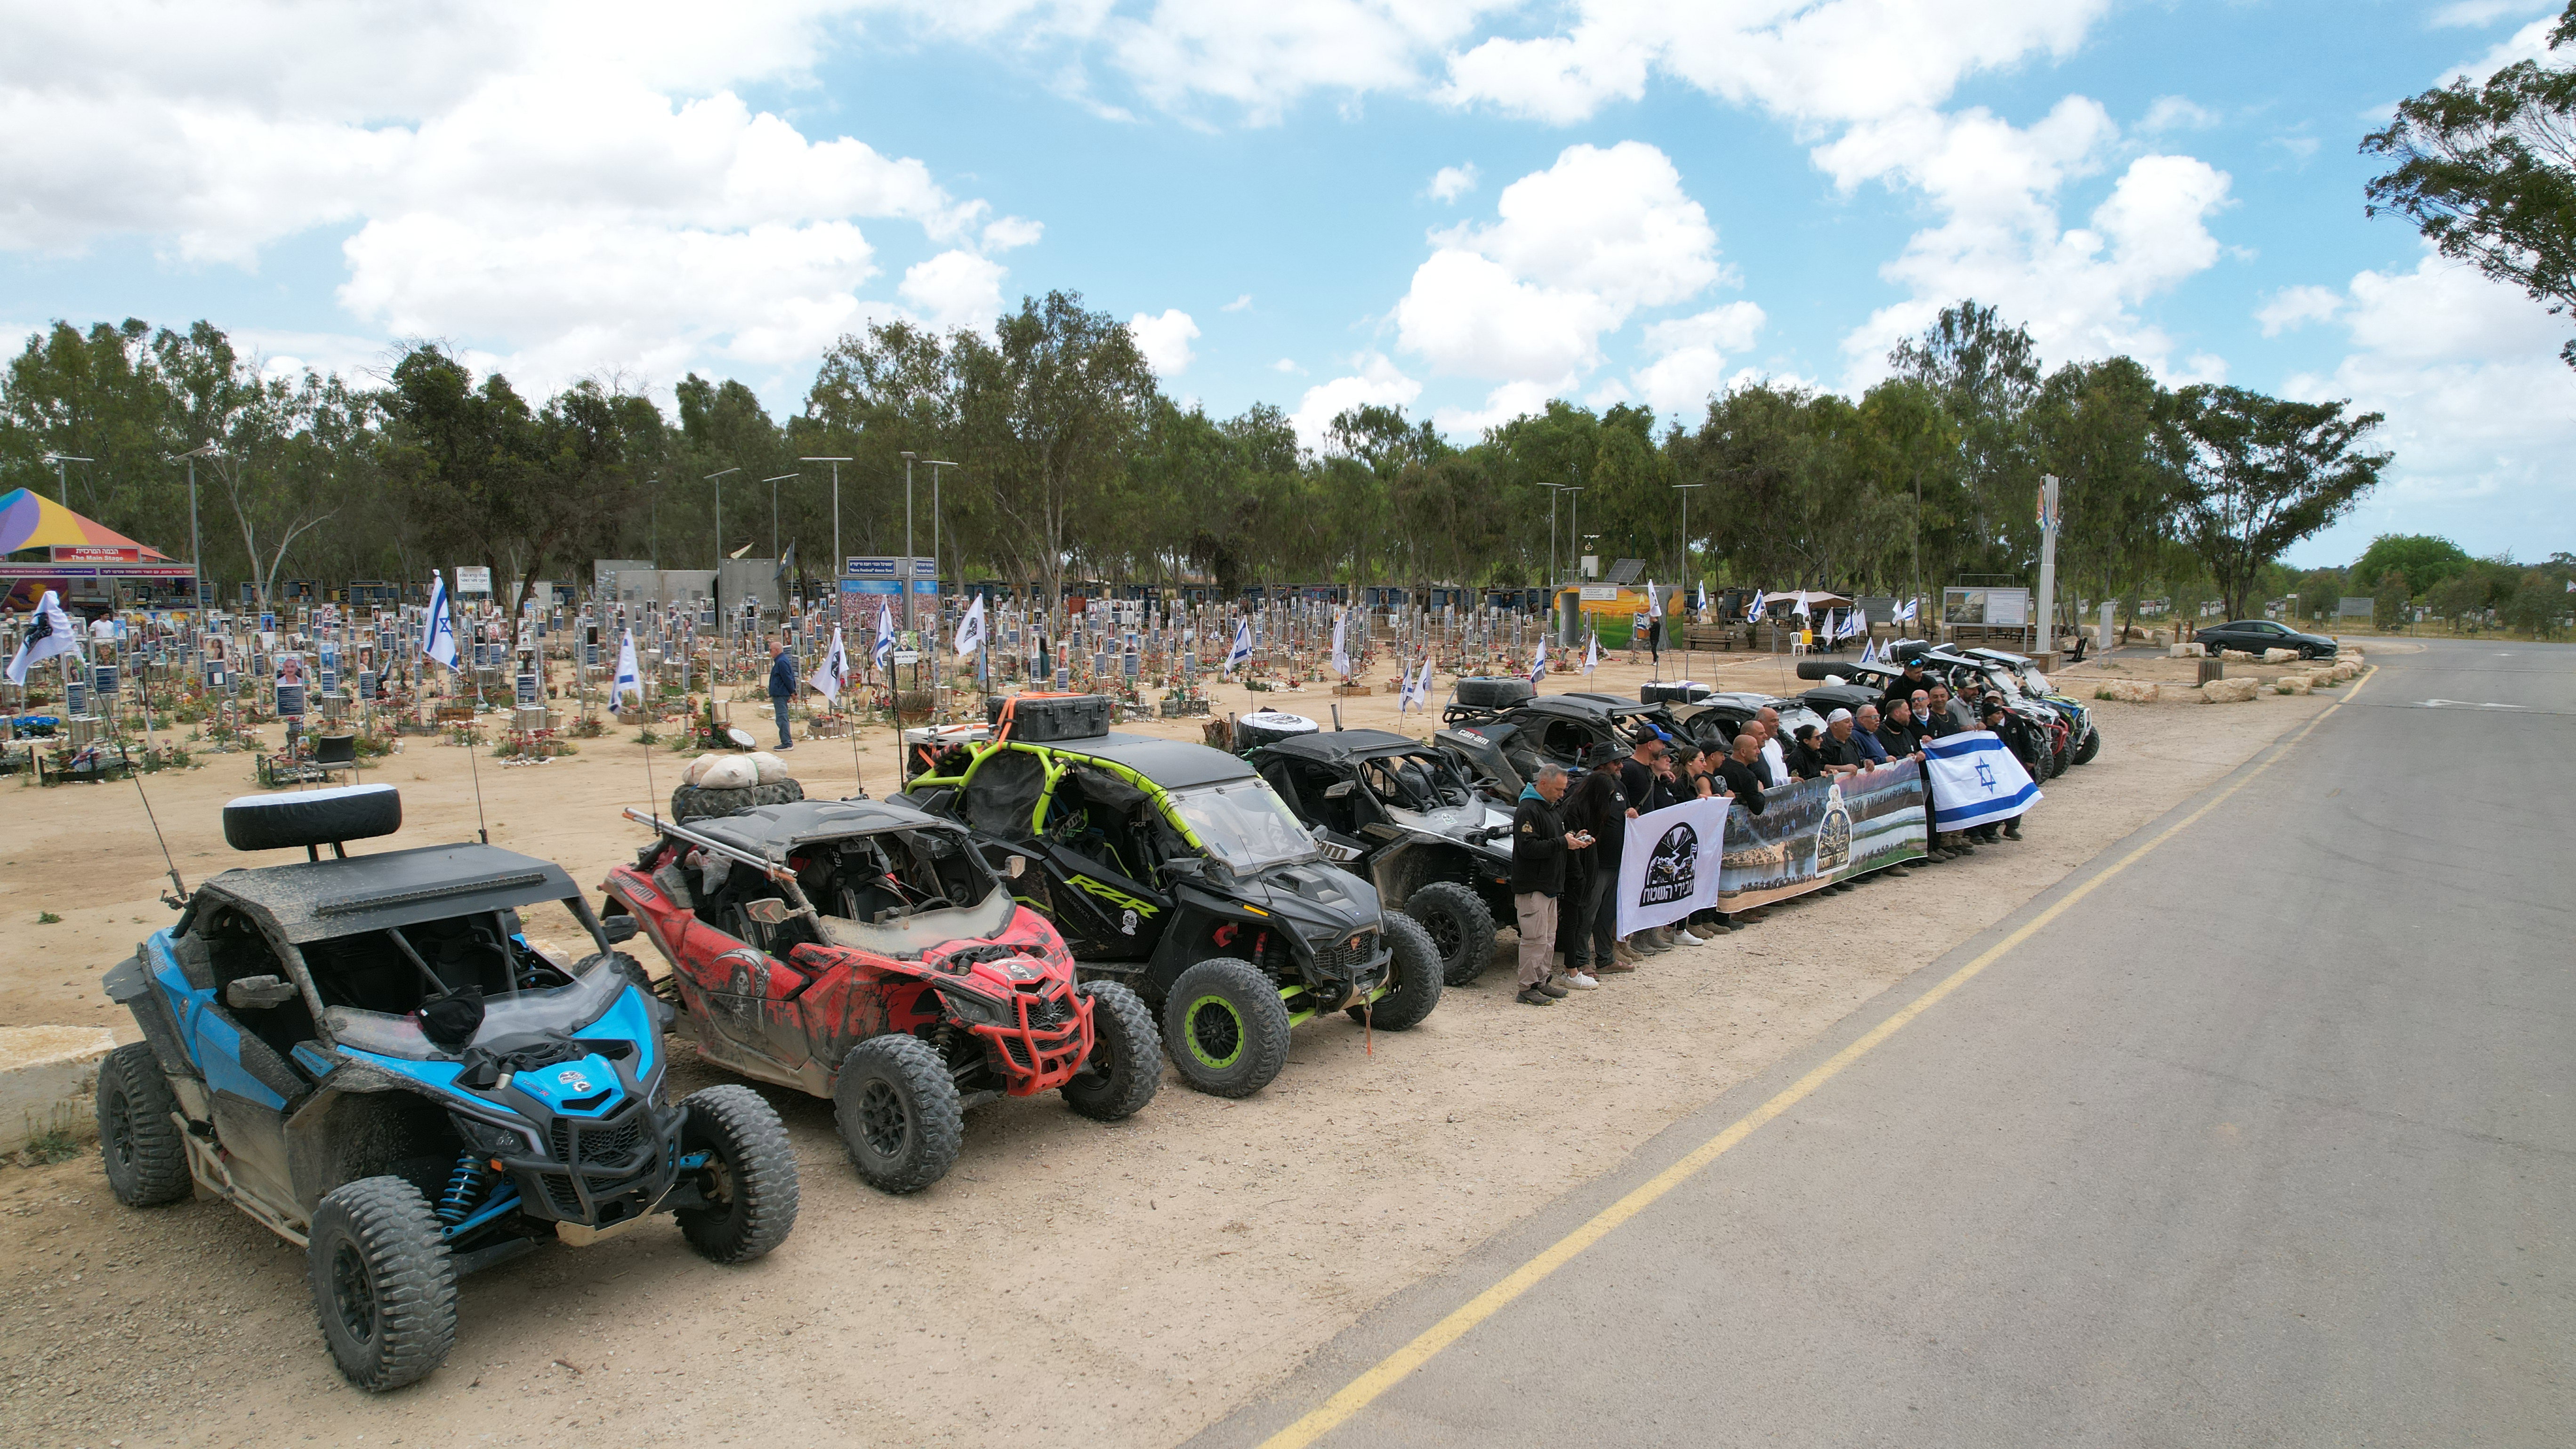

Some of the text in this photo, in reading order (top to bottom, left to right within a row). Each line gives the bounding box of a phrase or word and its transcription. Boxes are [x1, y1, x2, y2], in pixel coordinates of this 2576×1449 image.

[1818, 850, 1848, 869] אבירי השטח
[1063, 874, 1160, 919] RZR
[1643, 879, 1694, 903] אבירי השטח
[1060, 890, 1090, 919] ABRAMOVICH
[296, 1047, 323, 1071] MAVERICK
